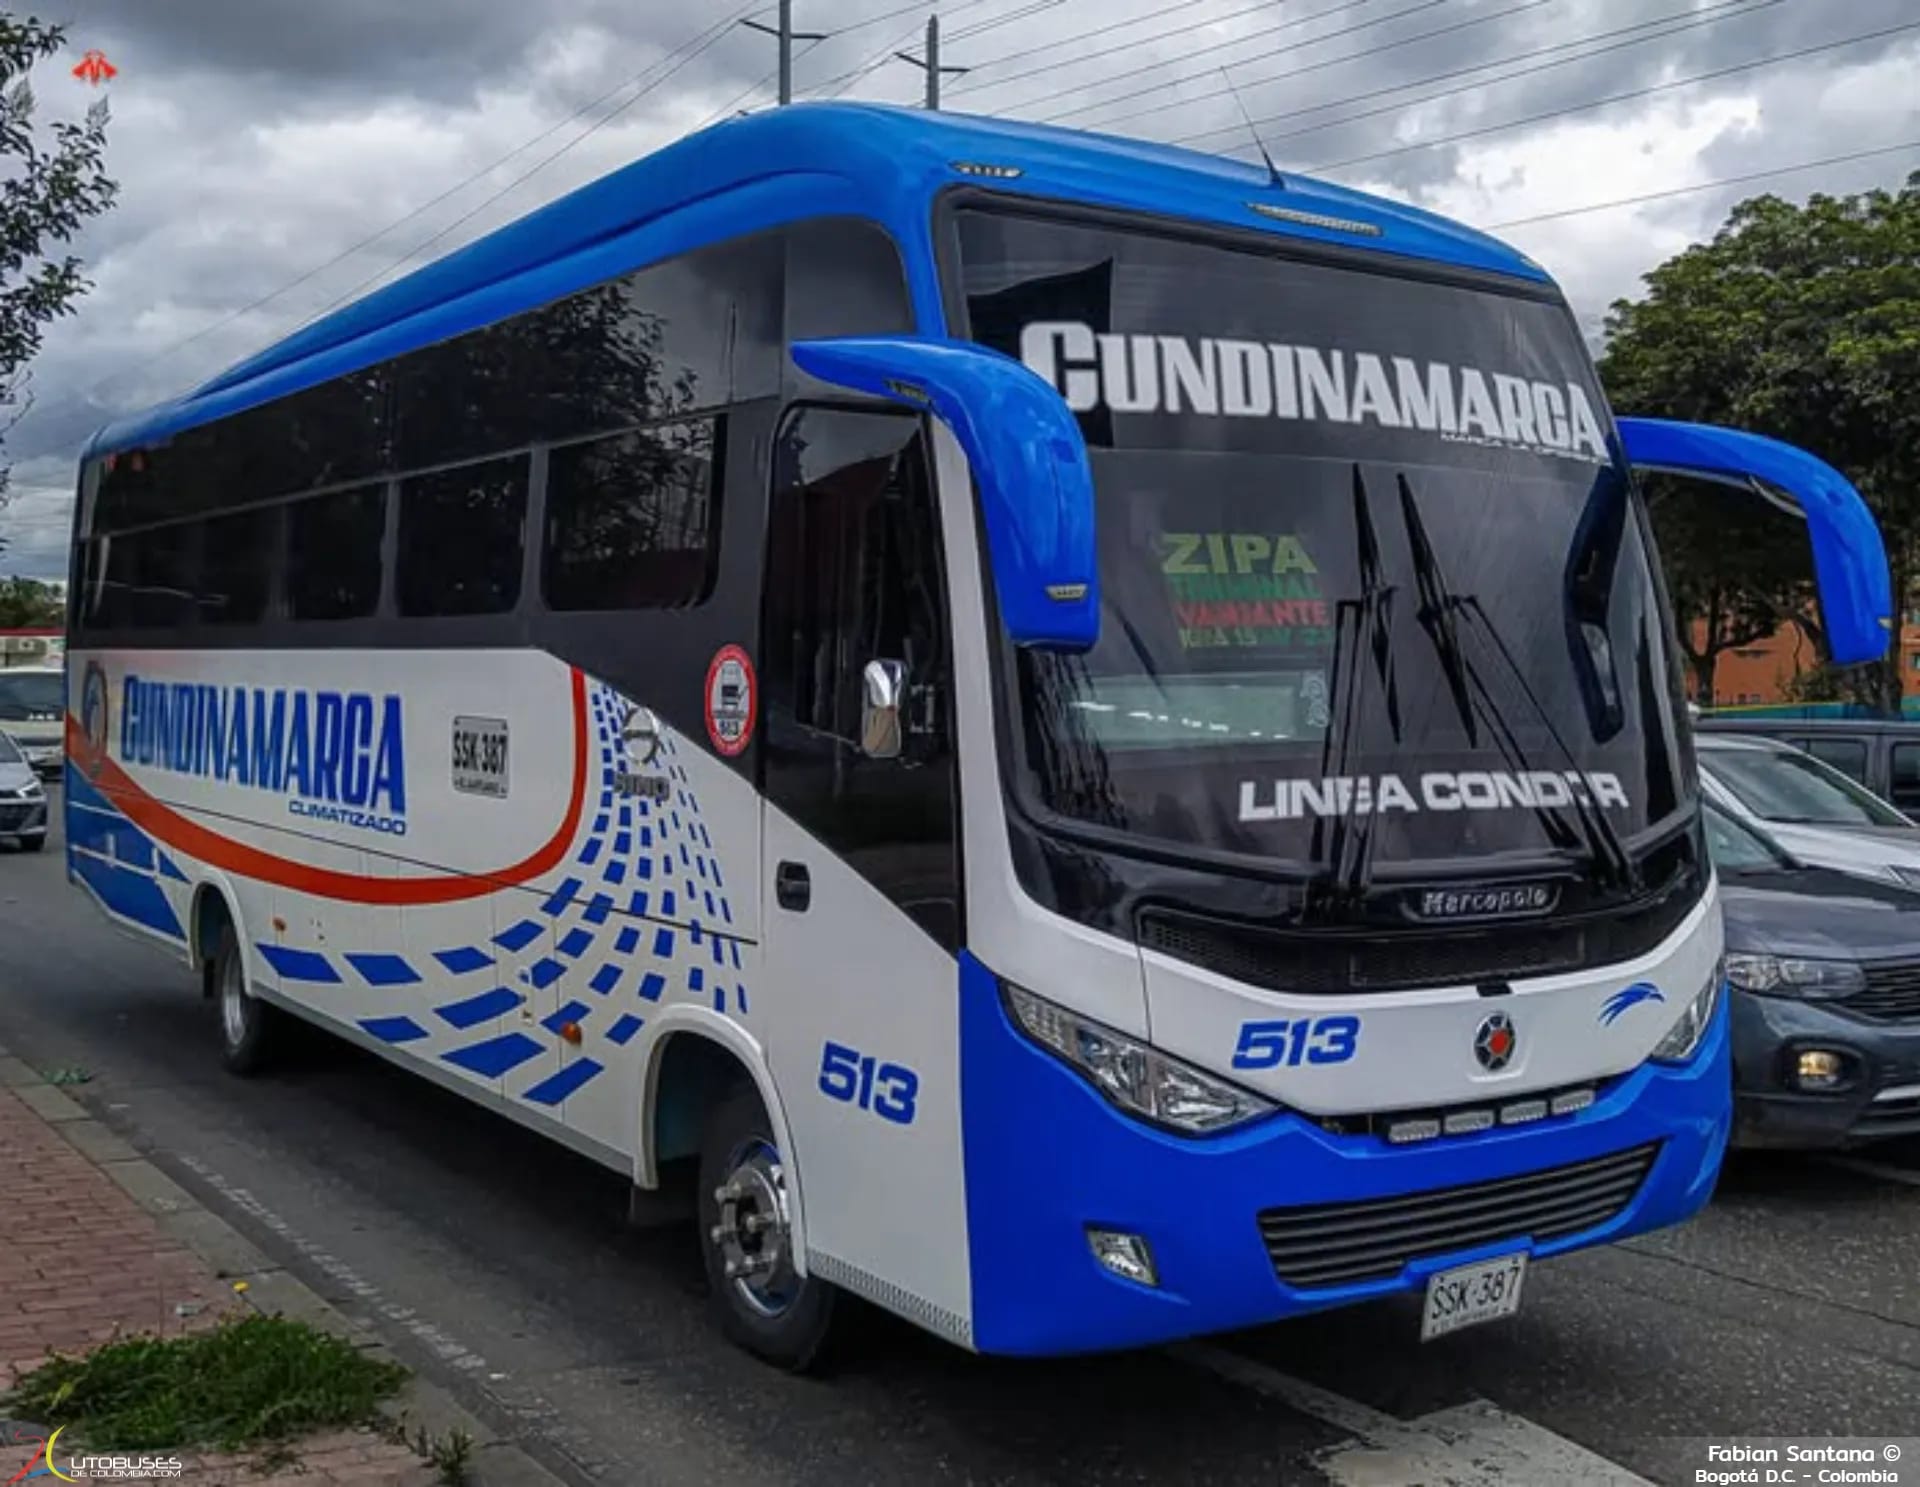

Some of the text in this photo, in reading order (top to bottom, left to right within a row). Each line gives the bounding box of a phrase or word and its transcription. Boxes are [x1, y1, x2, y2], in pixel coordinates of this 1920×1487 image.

[1020, 321, 1611, 459] CUNDINAMARCA
[1162, 533, 1318, 574] ZIPA
[121, 674, 406, 816] CUNDINAMARCA
[288, 799, 406, 836] CLIMATIZADO
[1239, 774, 1418, 822] LINEA
[1231, 1015, 1361, 1070] 513
[818, 1041, 919, 1125] 513
[1432, 1266, 1520, 1319] SSK-387
